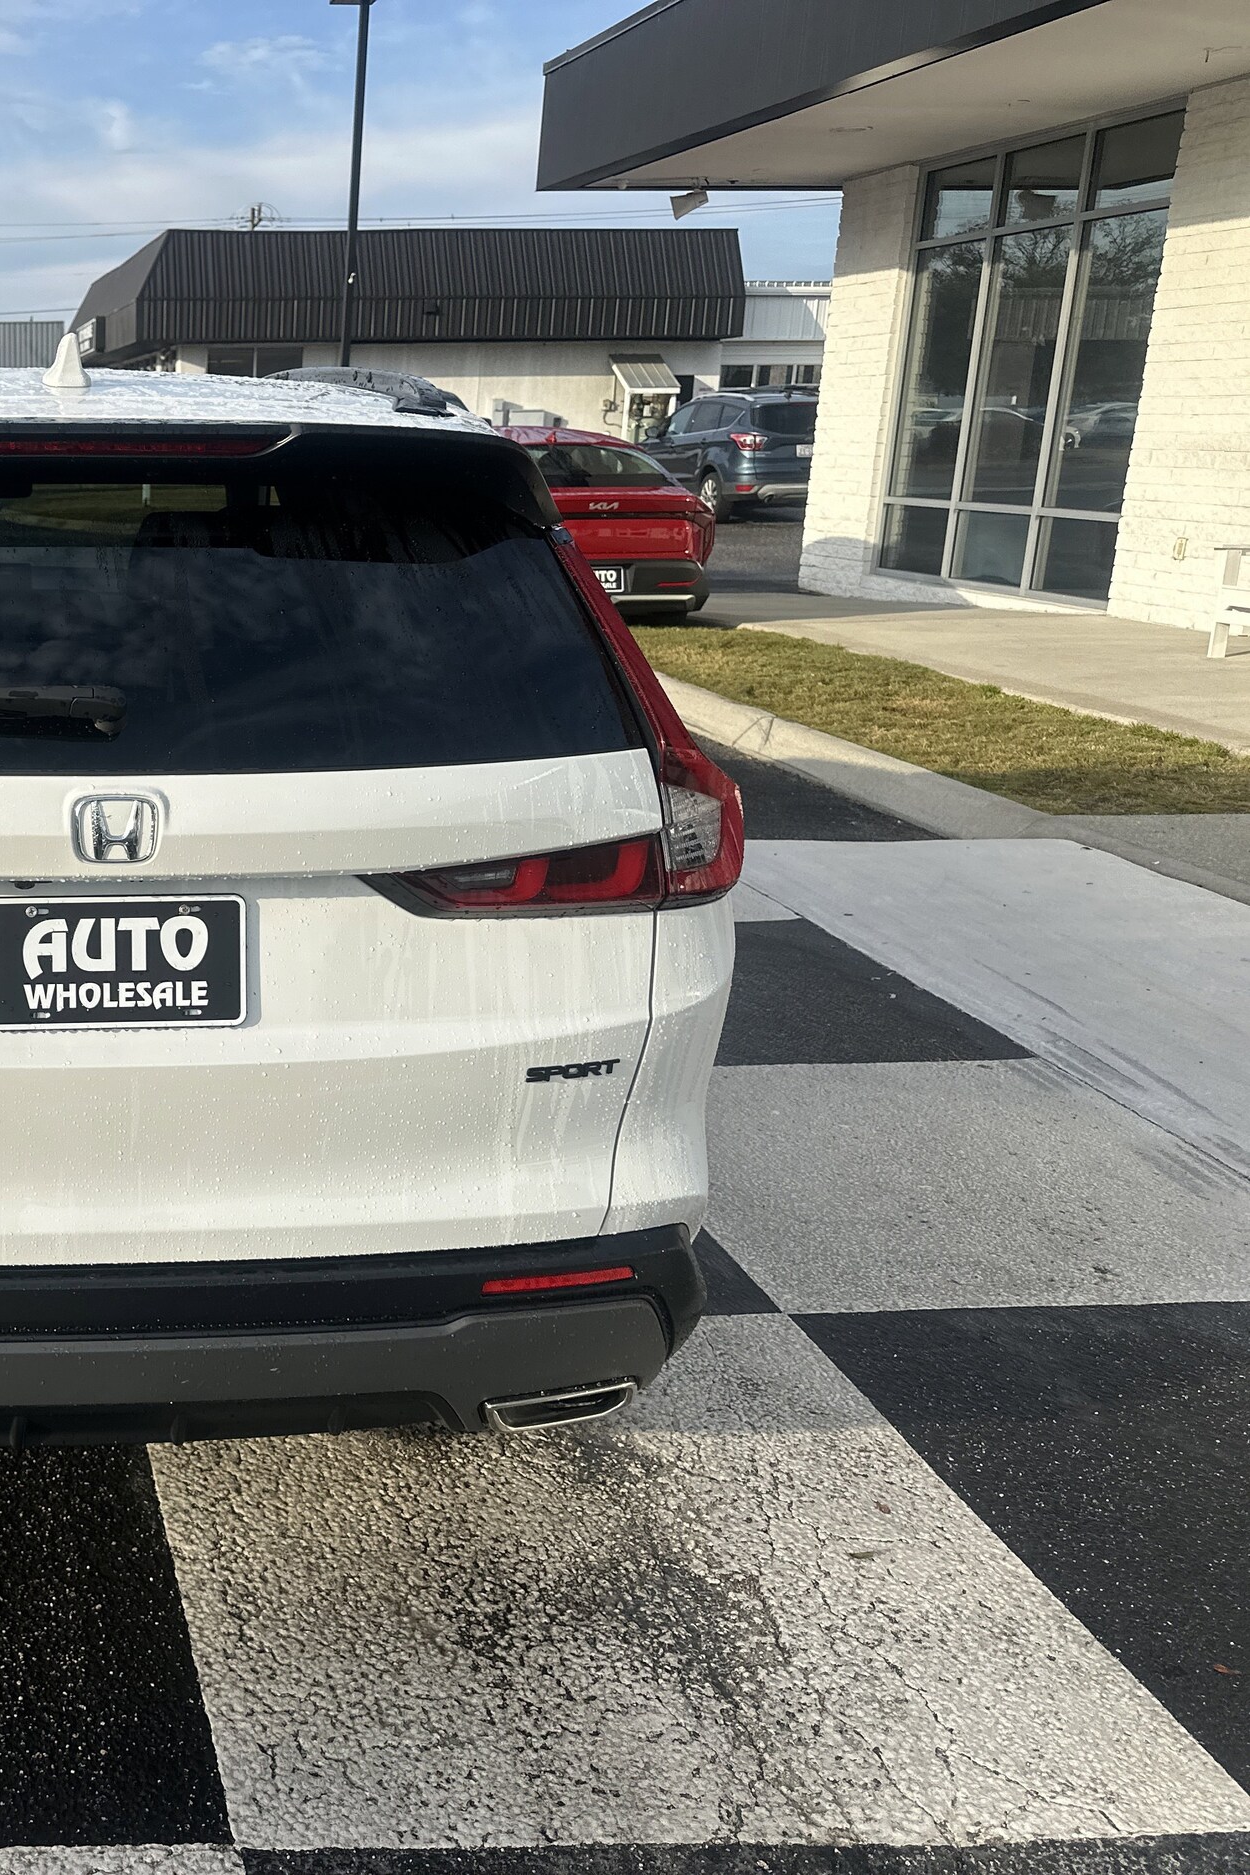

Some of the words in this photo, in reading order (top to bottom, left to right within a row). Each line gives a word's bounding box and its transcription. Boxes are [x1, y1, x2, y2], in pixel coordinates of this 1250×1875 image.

[22, 915, 209, 980] AUTO
[22, 981, 209, 1012] WHOLESALE
[525, 1058, 621, 1082] SPORT
